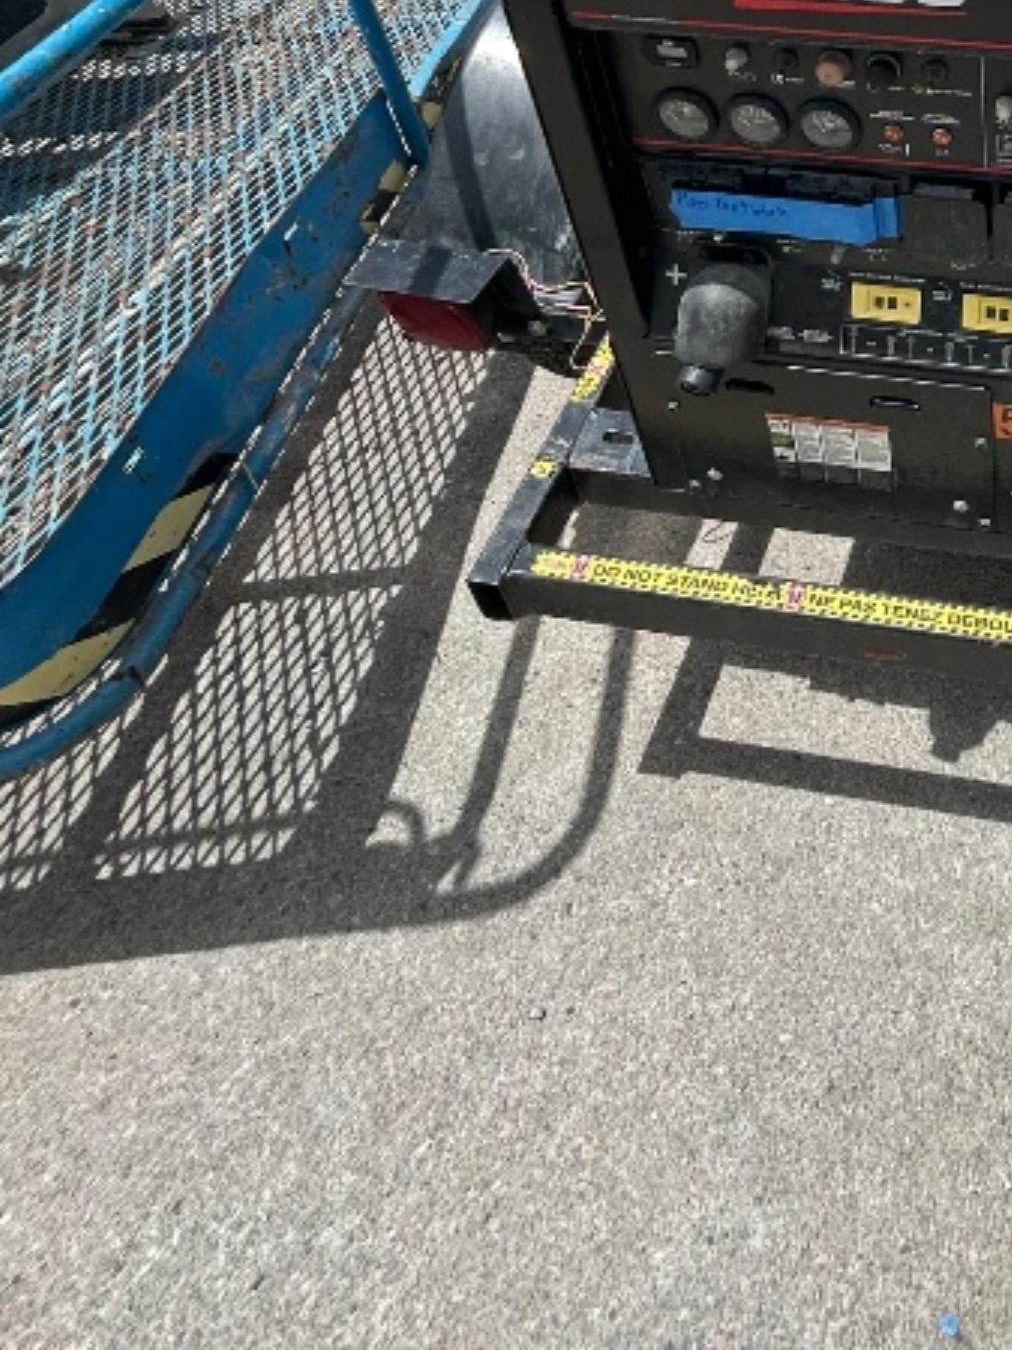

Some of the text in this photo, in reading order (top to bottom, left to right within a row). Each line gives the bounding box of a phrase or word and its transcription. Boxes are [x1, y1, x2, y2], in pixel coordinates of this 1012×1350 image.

[593, 563, 621, 578] DO
[623, 568, 661, 584] NOT
[666, 573, 728, 592] STAND
[839, 597, 877, 615] PAS
